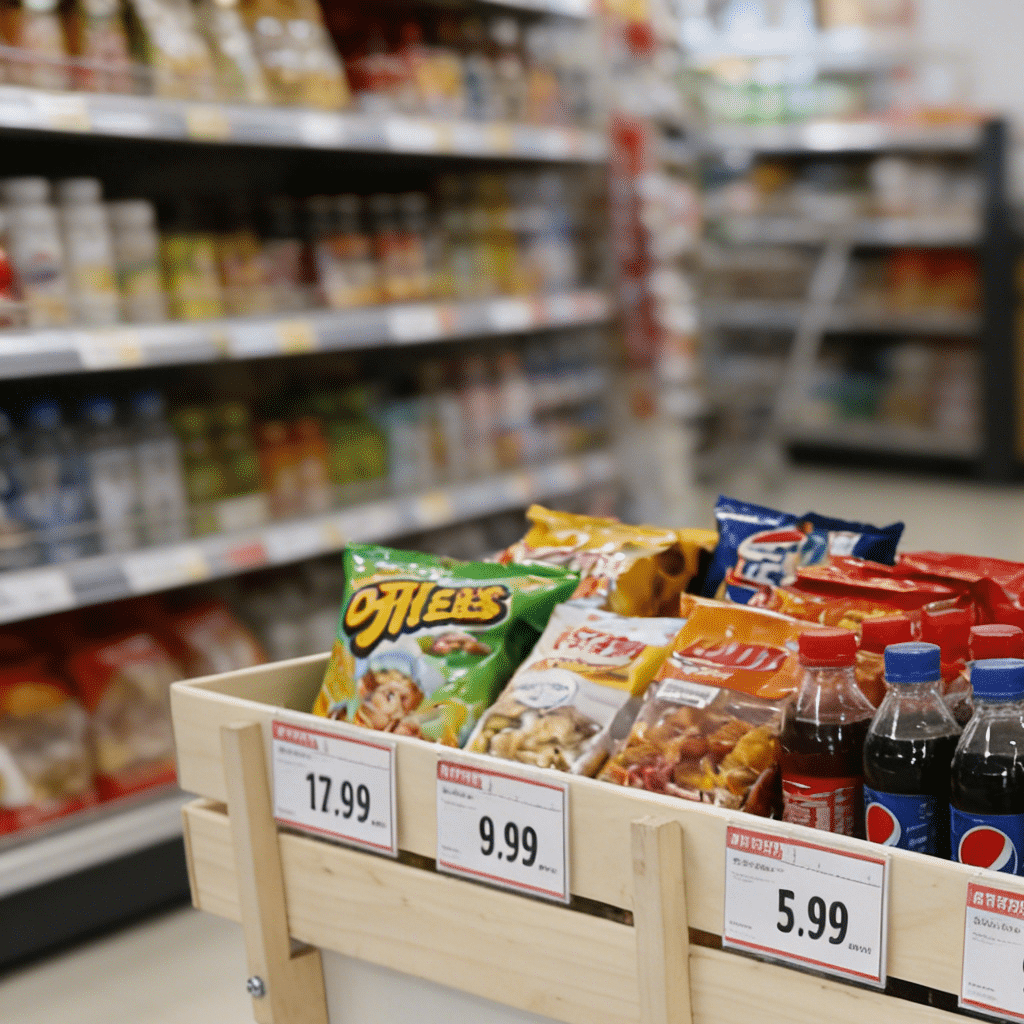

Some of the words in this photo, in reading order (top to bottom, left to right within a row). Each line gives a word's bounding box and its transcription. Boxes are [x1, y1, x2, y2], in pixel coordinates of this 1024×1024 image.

[306, 772, 371, 824] 17.99
[479, 814, 539, 868] 9.99
[776, 888, 849, 945] 5.99
